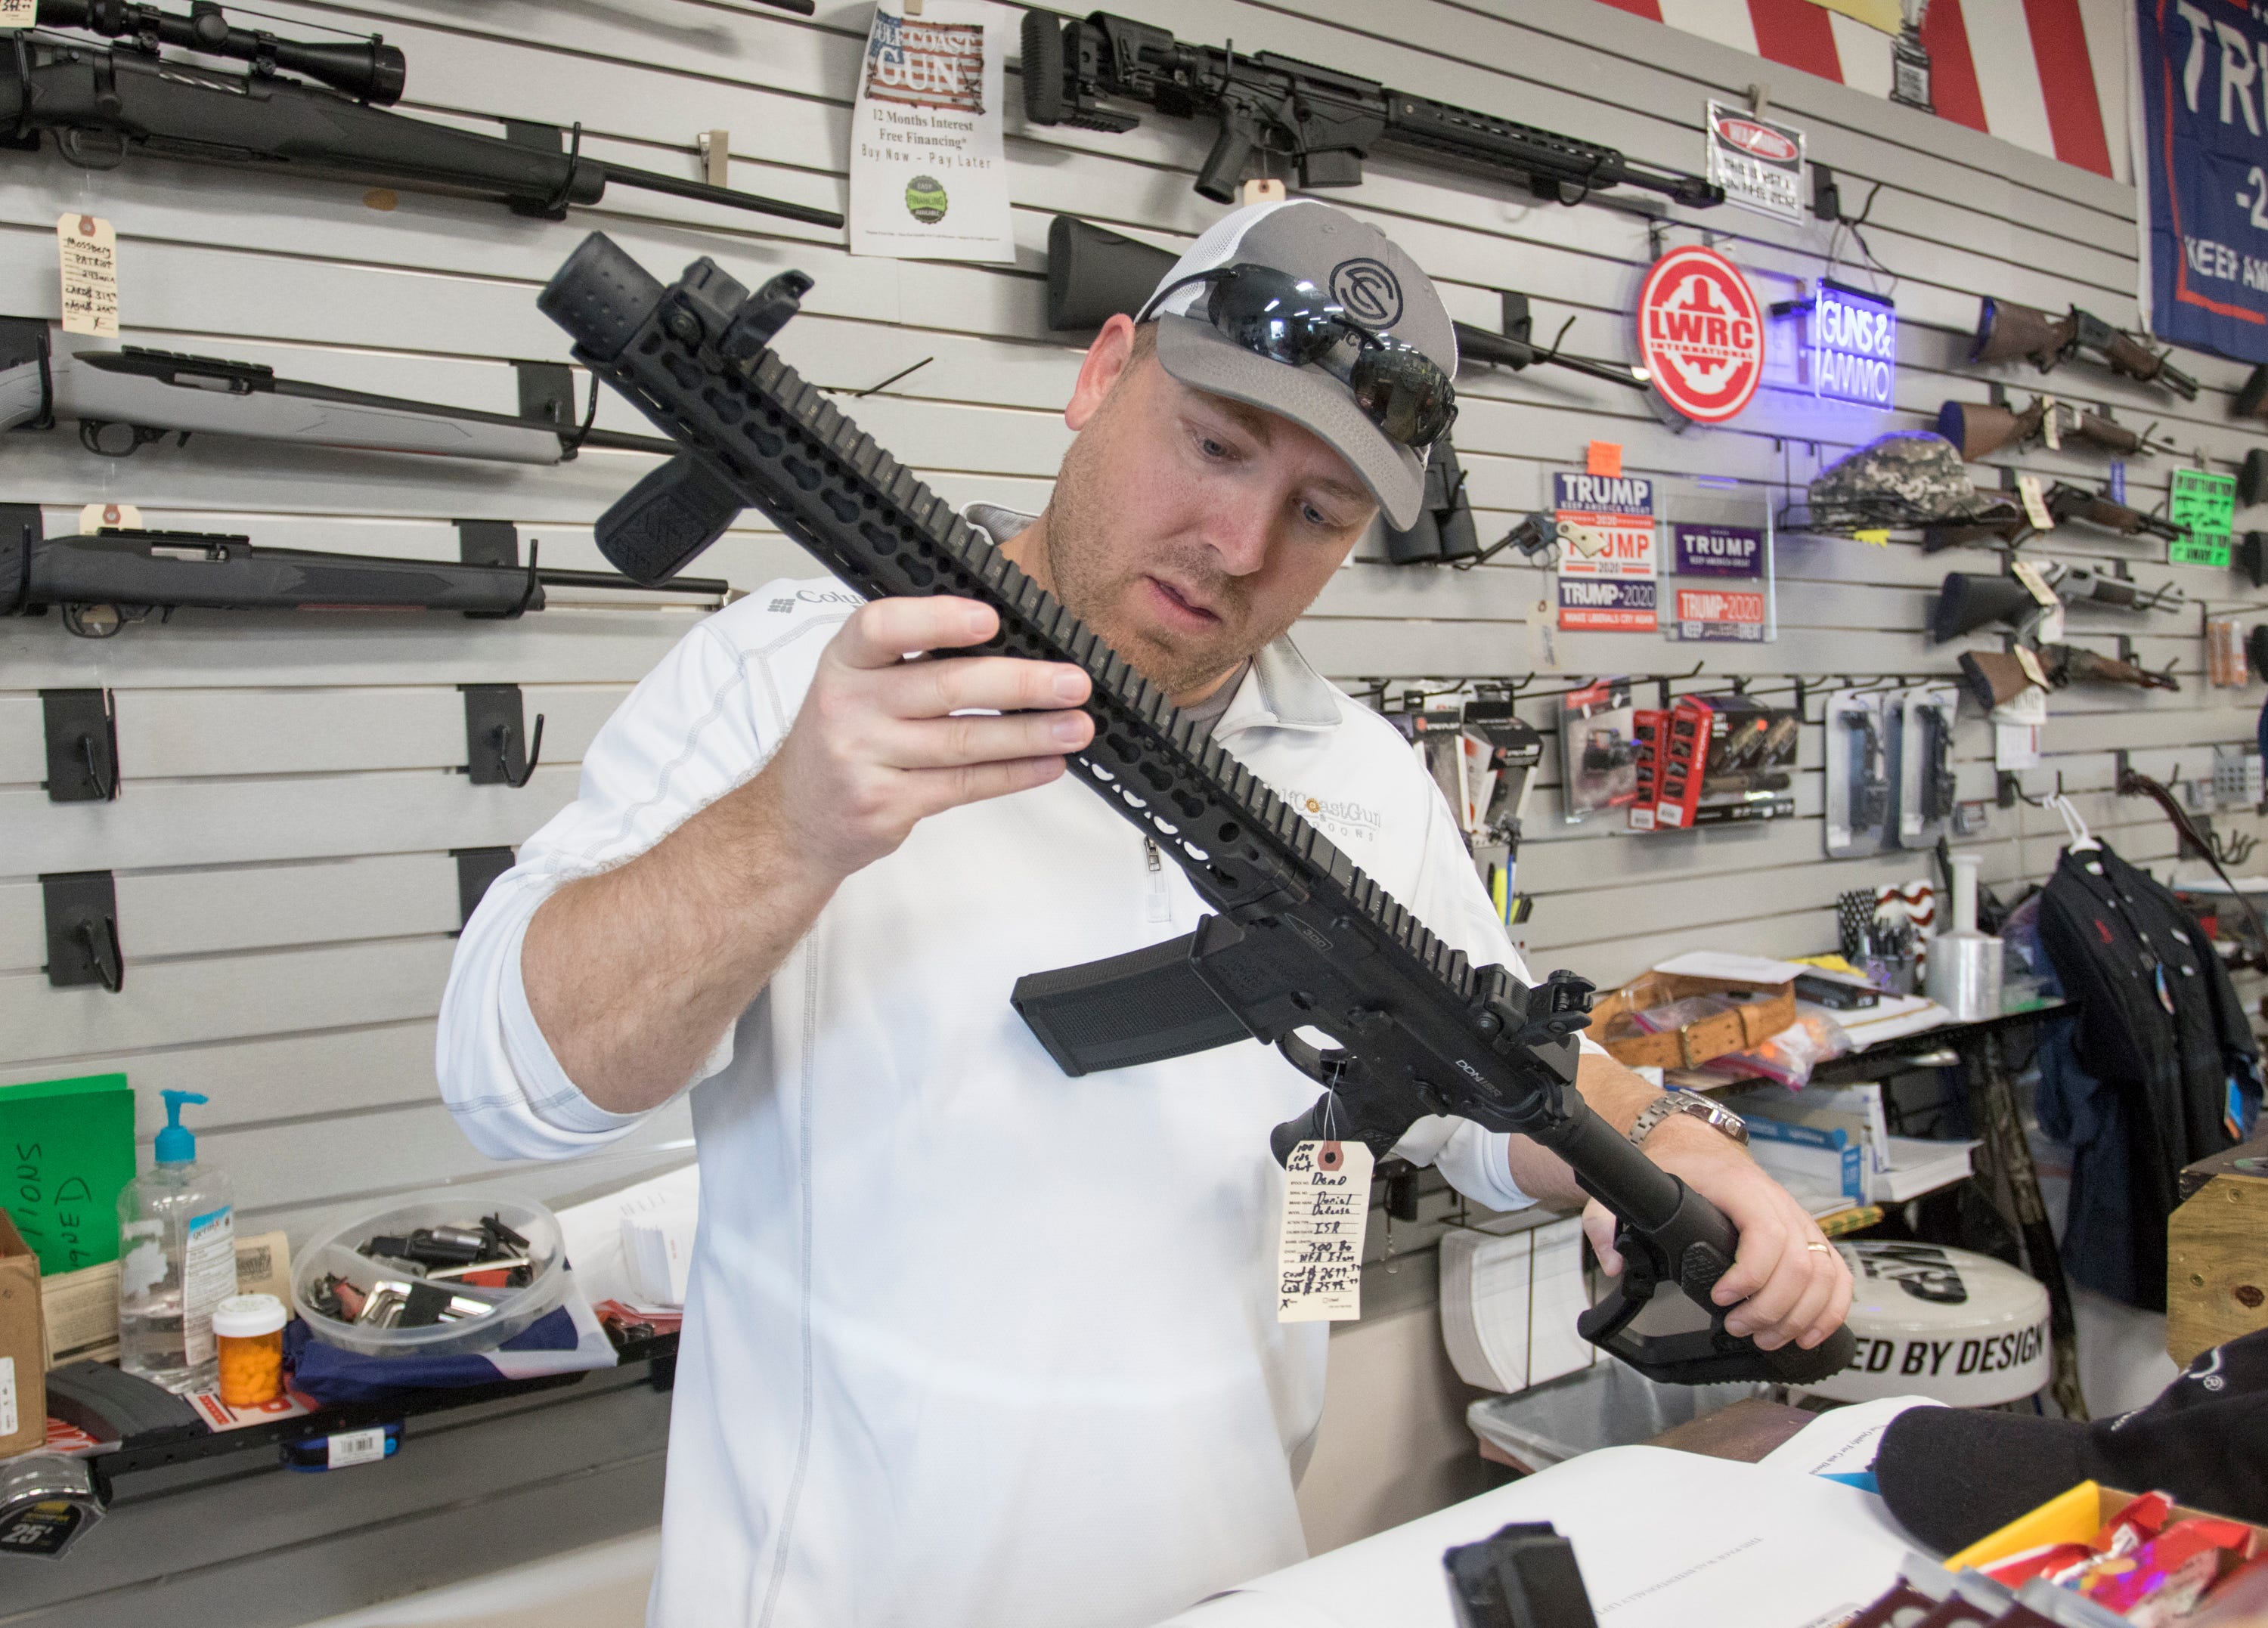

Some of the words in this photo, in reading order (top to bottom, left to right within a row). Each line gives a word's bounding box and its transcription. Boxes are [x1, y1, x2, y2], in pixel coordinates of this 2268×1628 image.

[874, 20, 903, 46] GULF
[909, 32, 974, 54] COAST
[877, 47, 959, 94] GUN
[873, 109, 883, 121] 12
[887, 111, 927, 127] Months
[931, 116, 974, 132] Interest
[880, 128, 903, 143] Free
[862, 144, 879, 162] Buy
[886, 148, 909, 161] Now
[929, 152, 952, 168] Pay
[958, 154, 991, 169] Later
[909, 194, 943, 206] FINANCING
[2184, 234, 2239, 281] KEEP
[1650, 309, 1754, 349] LWRC
[1821, 299, 1873, 353] GUNS
[1874, 313, 1891, 357] &
[1650, 342, 1753, 359] INTERNATIONAL
[1820, 348, 1890, 402] AMMO
[1561, 474, 1648, 506] TRUMP
[1681, 534, 1756, 557] TRUMP
[795, 590, 869, 605] Colu
[1560, 581, 1619, 605] TRUMP
[1623, 584, 1656, 608] 2020
[1681, 593, 1724, 618] TRUMP
[1727, 595, 1761, 620] 2020
[1303, 929, 1328, 948] 300
[1318, 1191, 1352, 1206] Daniel
[1300, 1252, 1322, 1263] NFA
[1900, 1340, 1955, 1376] BY
